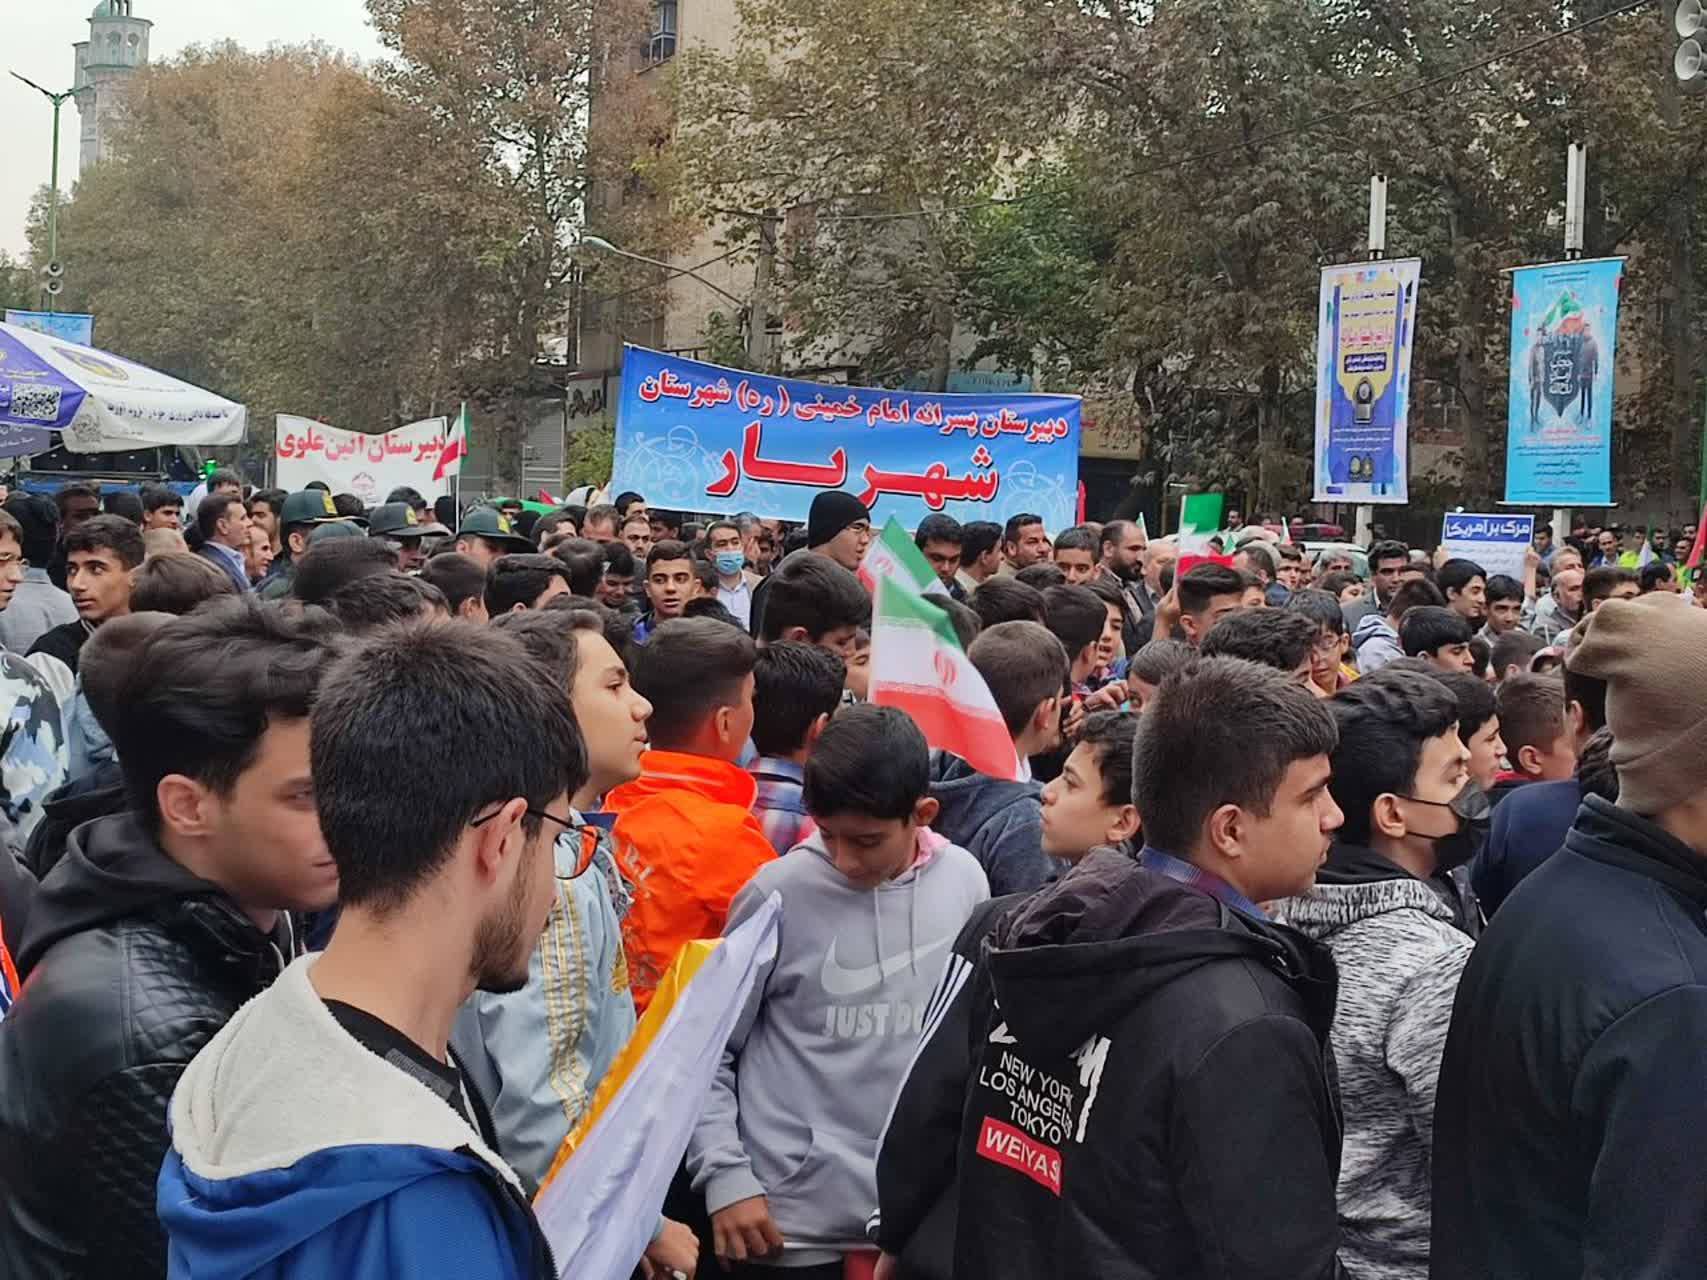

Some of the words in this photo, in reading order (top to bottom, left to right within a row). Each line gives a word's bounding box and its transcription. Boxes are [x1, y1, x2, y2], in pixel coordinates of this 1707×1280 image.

[639, 368, 732, 407] شهرستان
[793, 393, 862, 421] خمینی
[867, 398, 910, 427] امام
[912, 401, 978, 438] پسرانه
[980, 407, 1069, 443] دبیرستان
[276, 427, 324, 459] علوی
[1486, 523, 1500, 537] بر
[823, 1002, 889, 1039] JUST
[980, 1066, 1017, 1097] LOS
[1000, 1051, 1035, 1085] NEW
[1010, 1101, 1062, 1145] TOKYO
